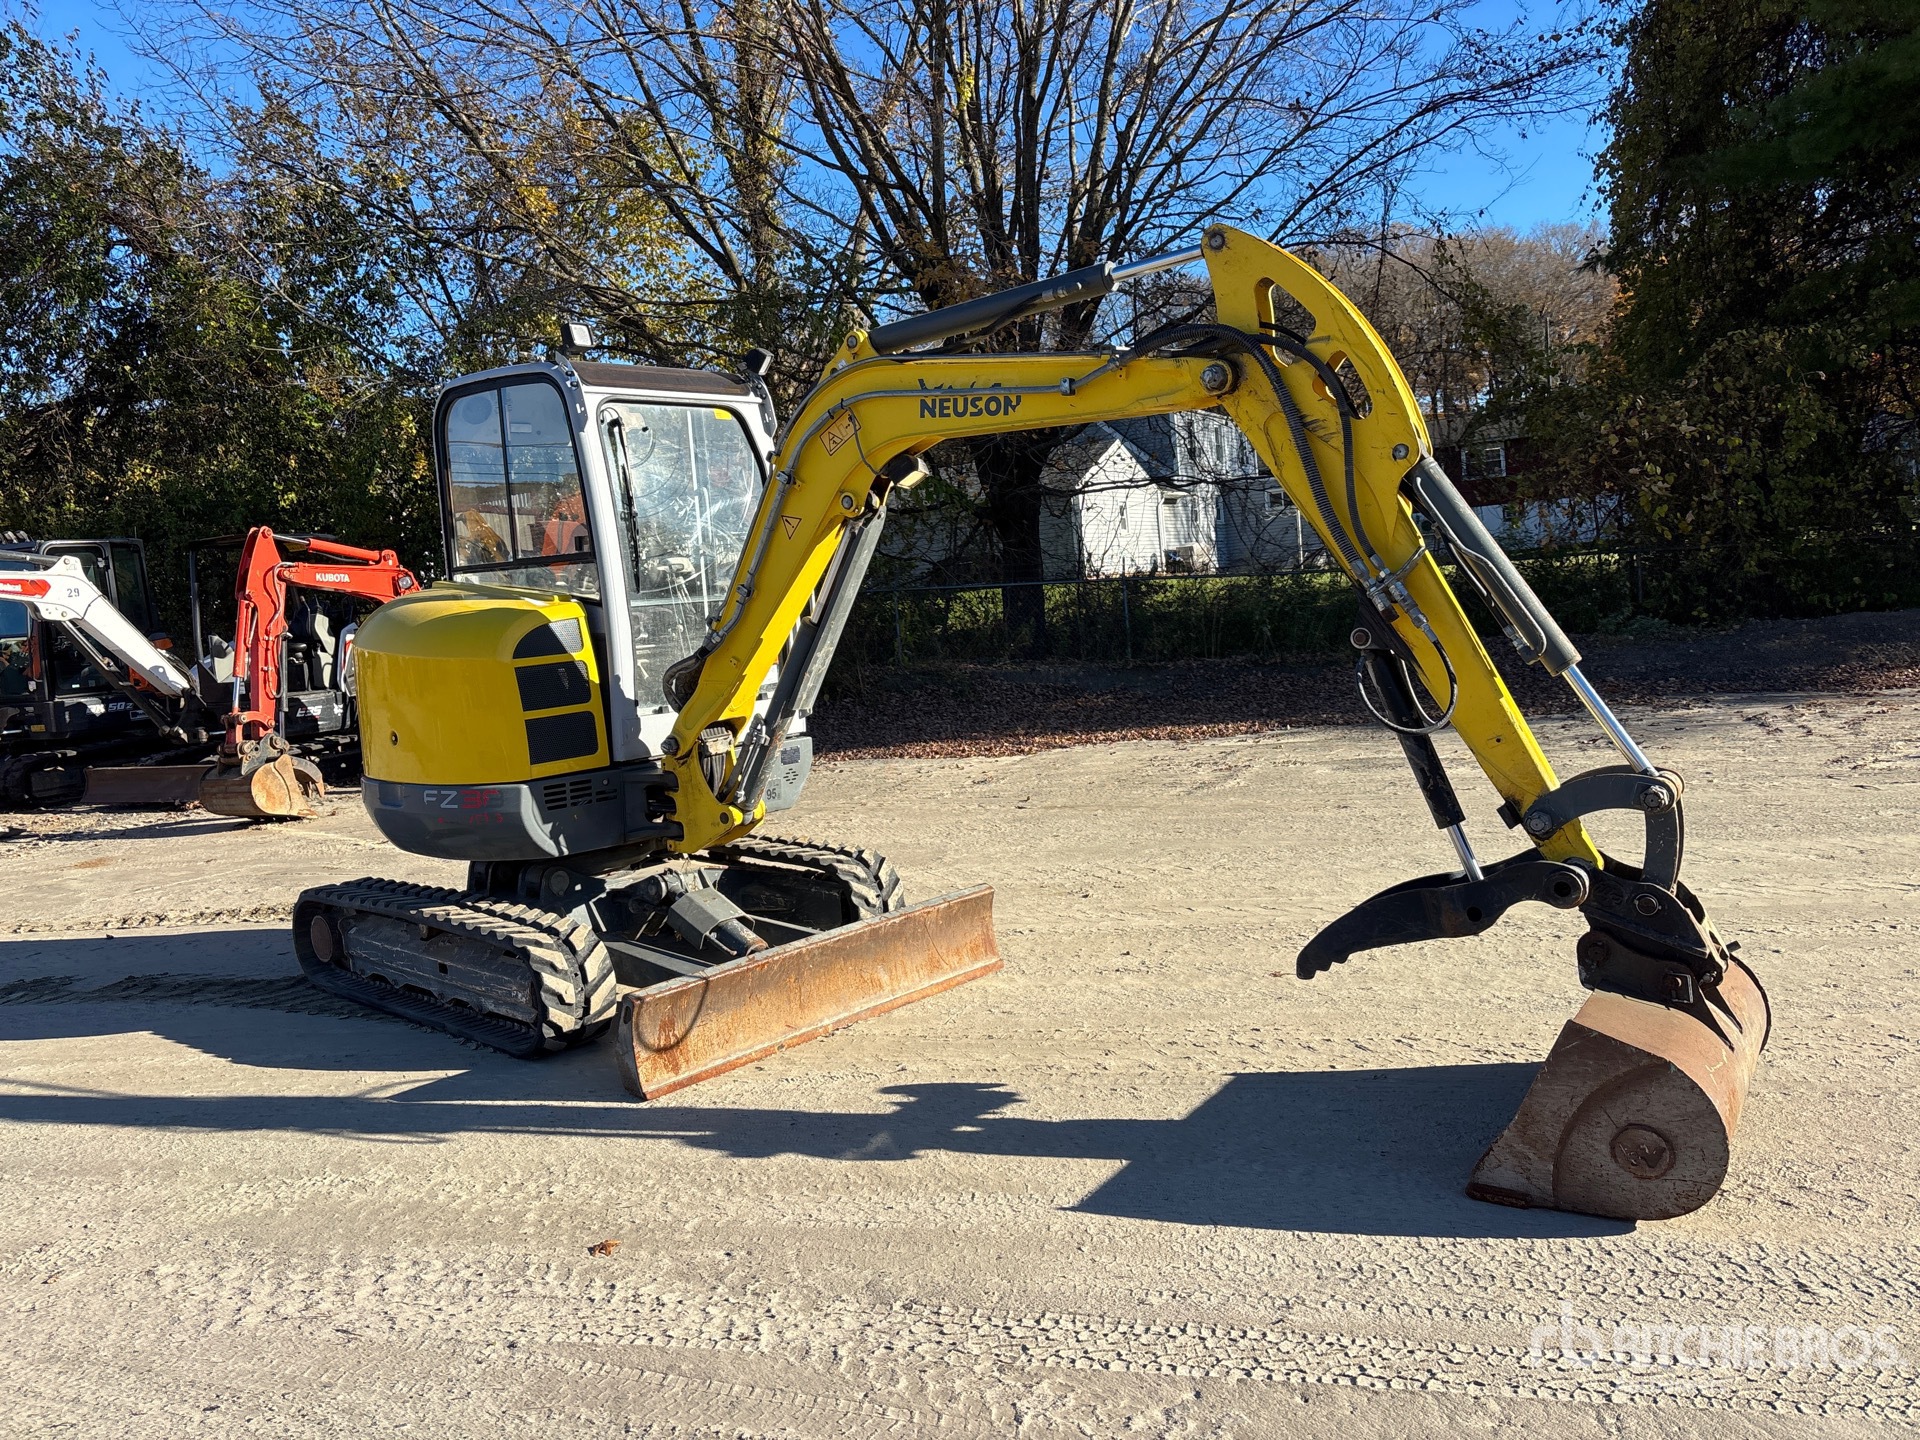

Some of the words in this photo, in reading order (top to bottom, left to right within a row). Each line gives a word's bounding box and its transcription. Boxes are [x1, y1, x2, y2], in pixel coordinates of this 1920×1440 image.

[919, 394, 1022, 419] NEUSON
[315, 572, 351, 583] KUBOTA
[66, 587, 80, 598] 29
[766, 787, 777, 800] 95
